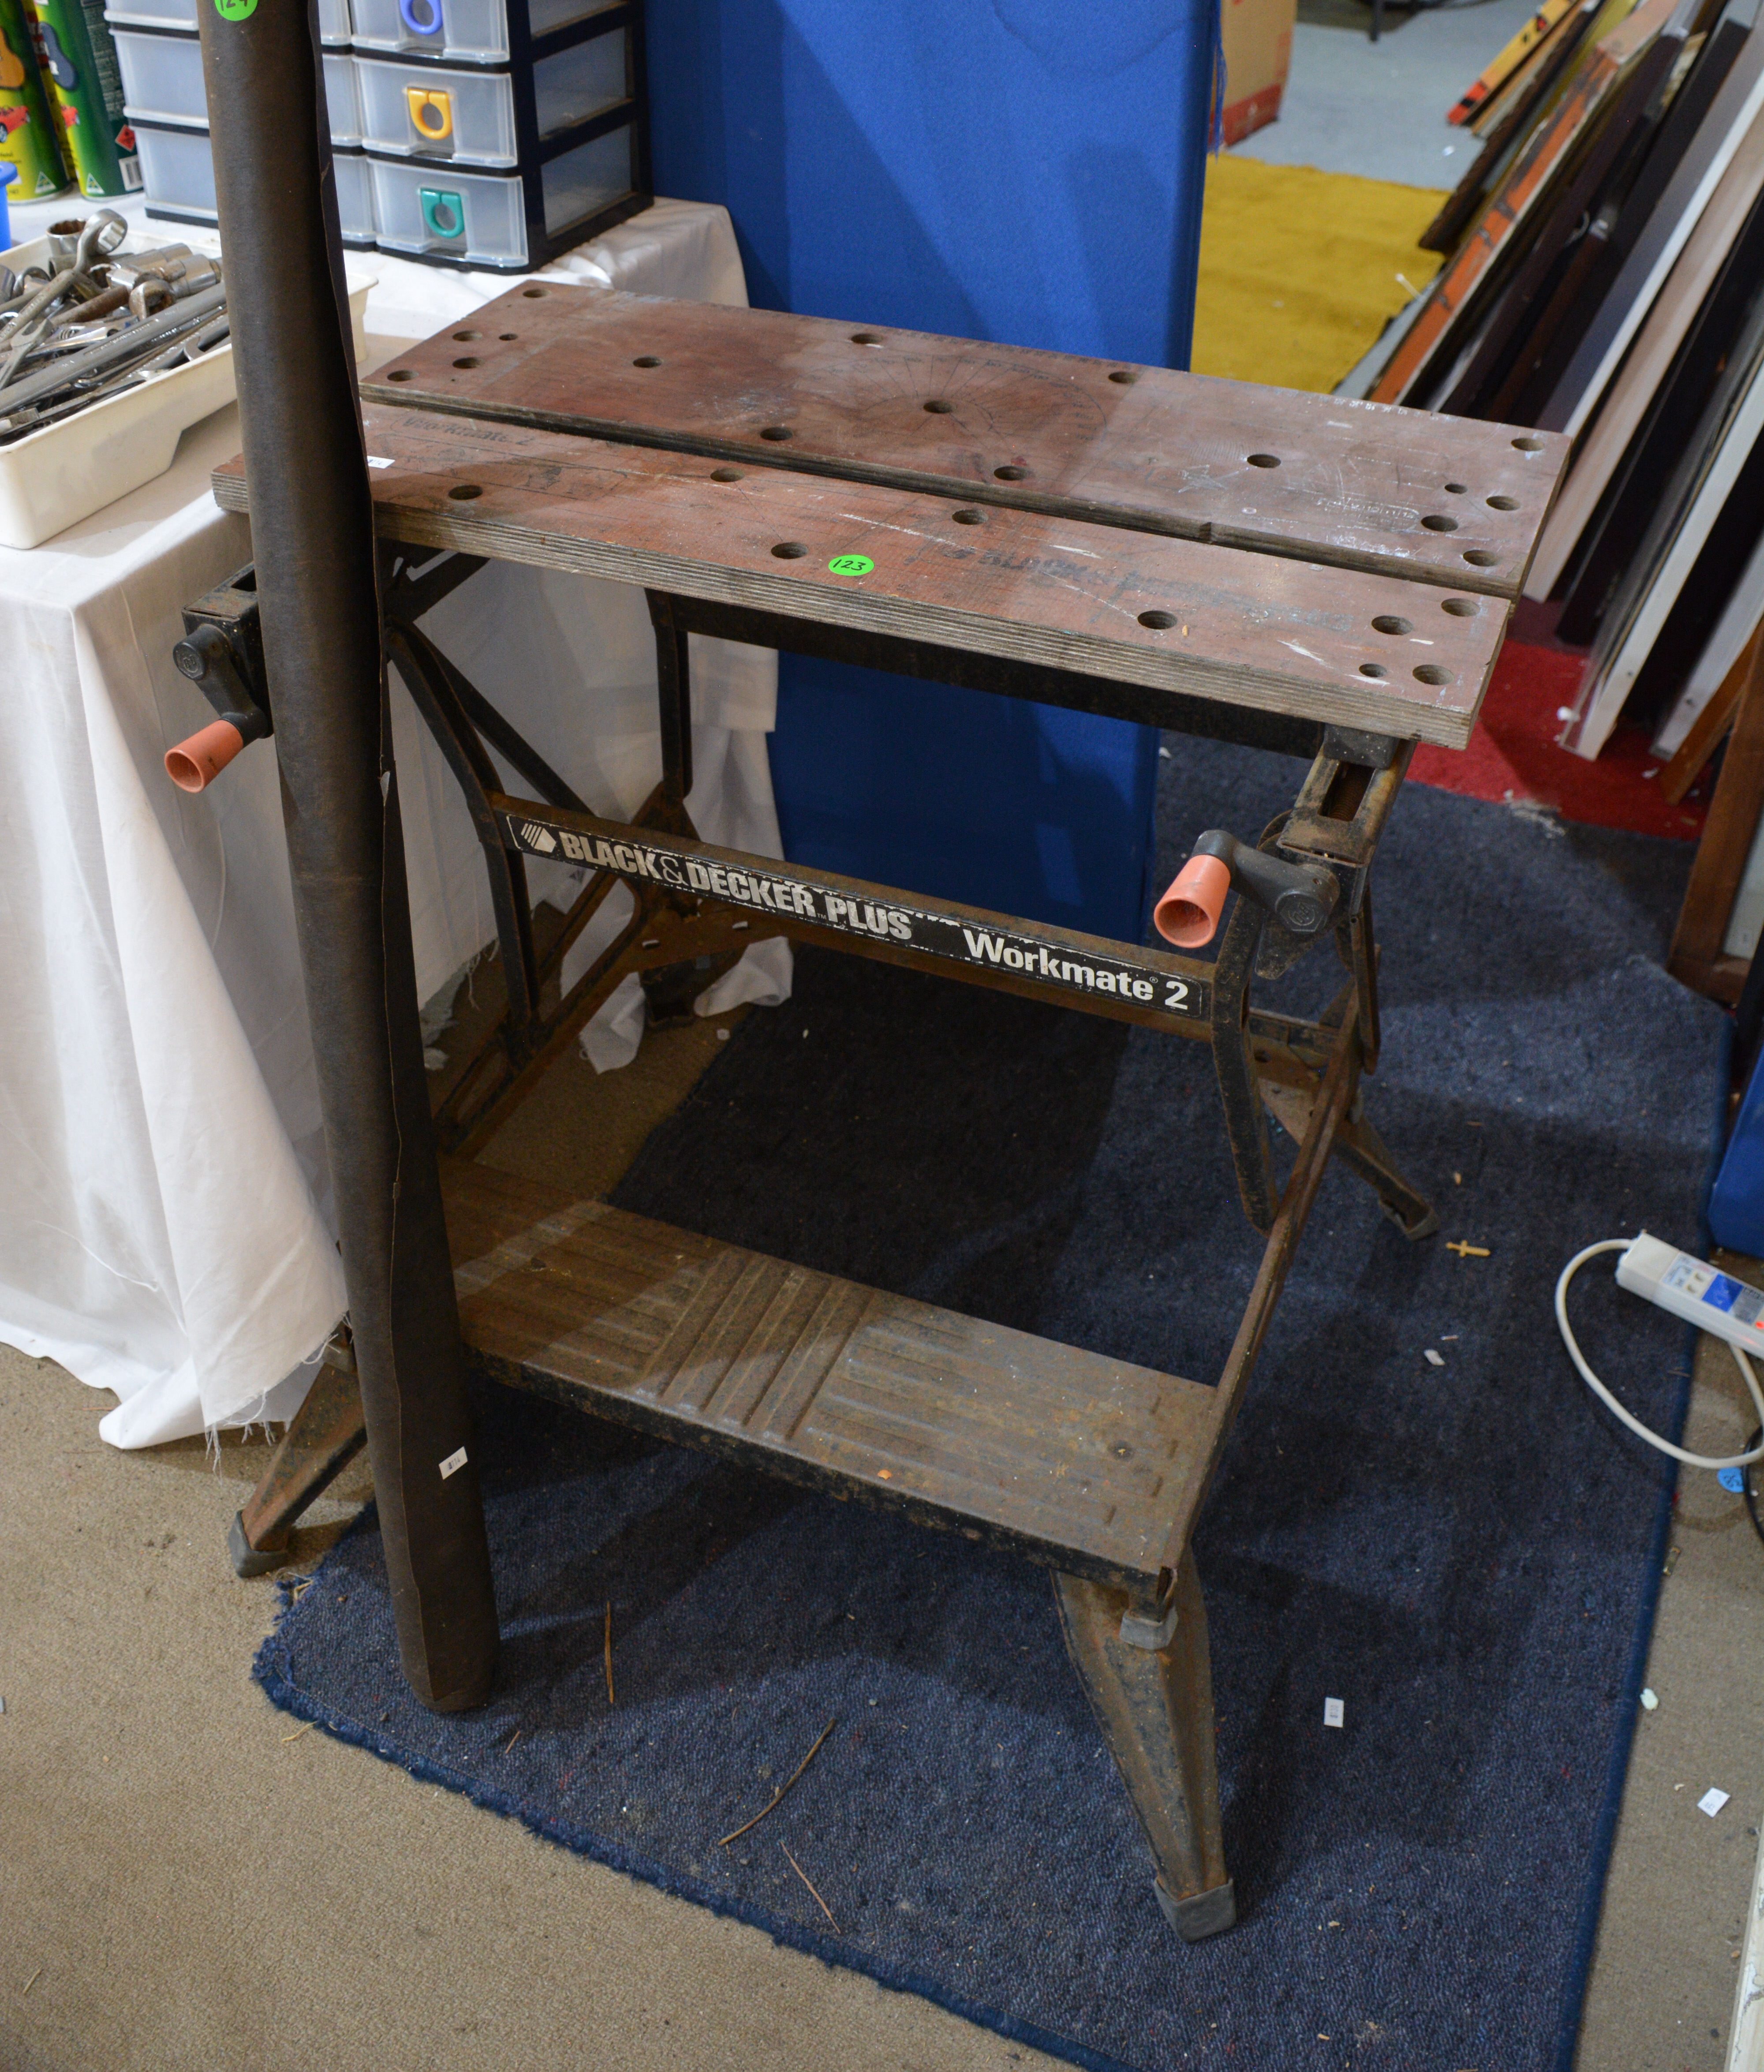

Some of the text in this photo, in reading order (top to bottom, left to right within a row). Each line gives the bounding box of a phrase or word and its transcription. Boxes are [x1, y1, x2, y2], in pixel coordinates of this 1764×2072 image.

[833, 559, 867, 571] 123
[825, 895, 912, 940] PLUS
[1164, 980, 1188, 1010] 2
